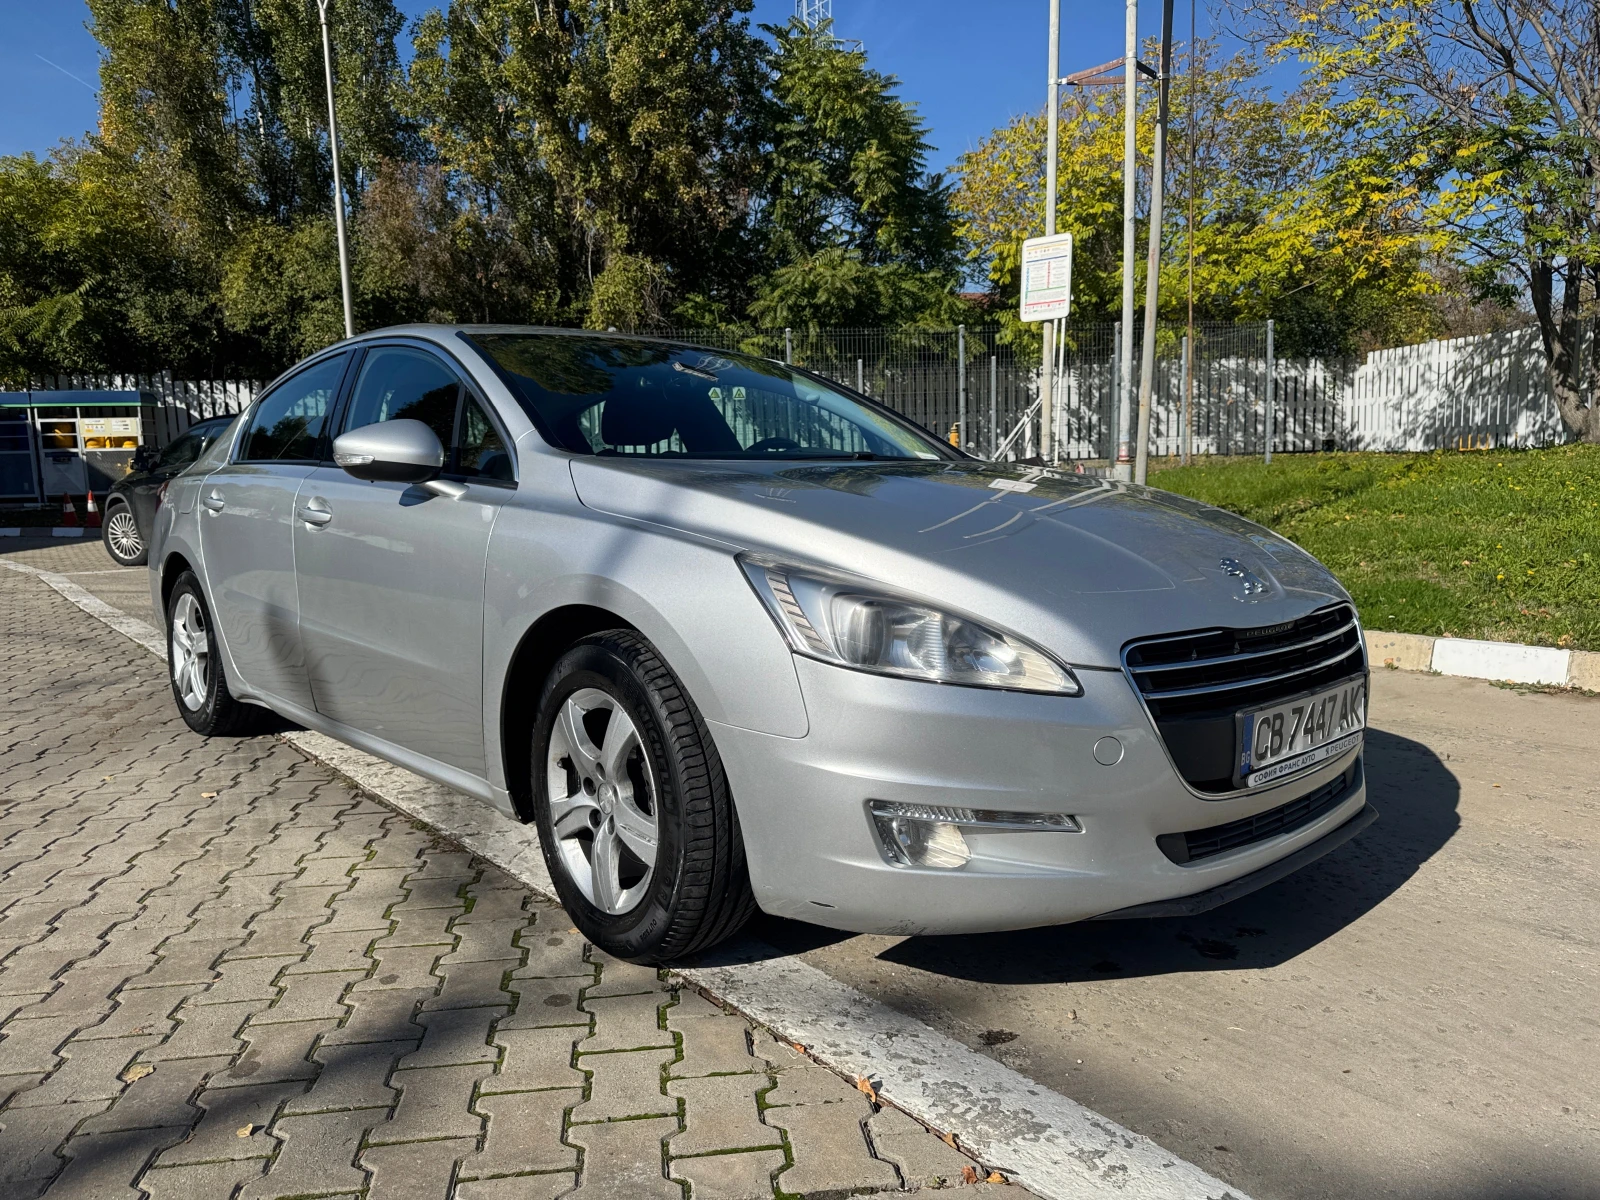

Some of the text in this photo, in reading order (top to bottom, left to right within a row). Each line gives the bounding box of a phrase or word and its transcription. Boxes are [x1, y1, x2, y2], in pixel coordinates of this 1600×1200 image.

[1254, 682, 1364, 761] CB 7447 AK
[636, 703, 675, 811] MICHELIN
[1241, 751, 1251, 766] BG
[1253, 735, 1360, 783] СОФИЯ ФРАНС АУТО PEUGEOT
